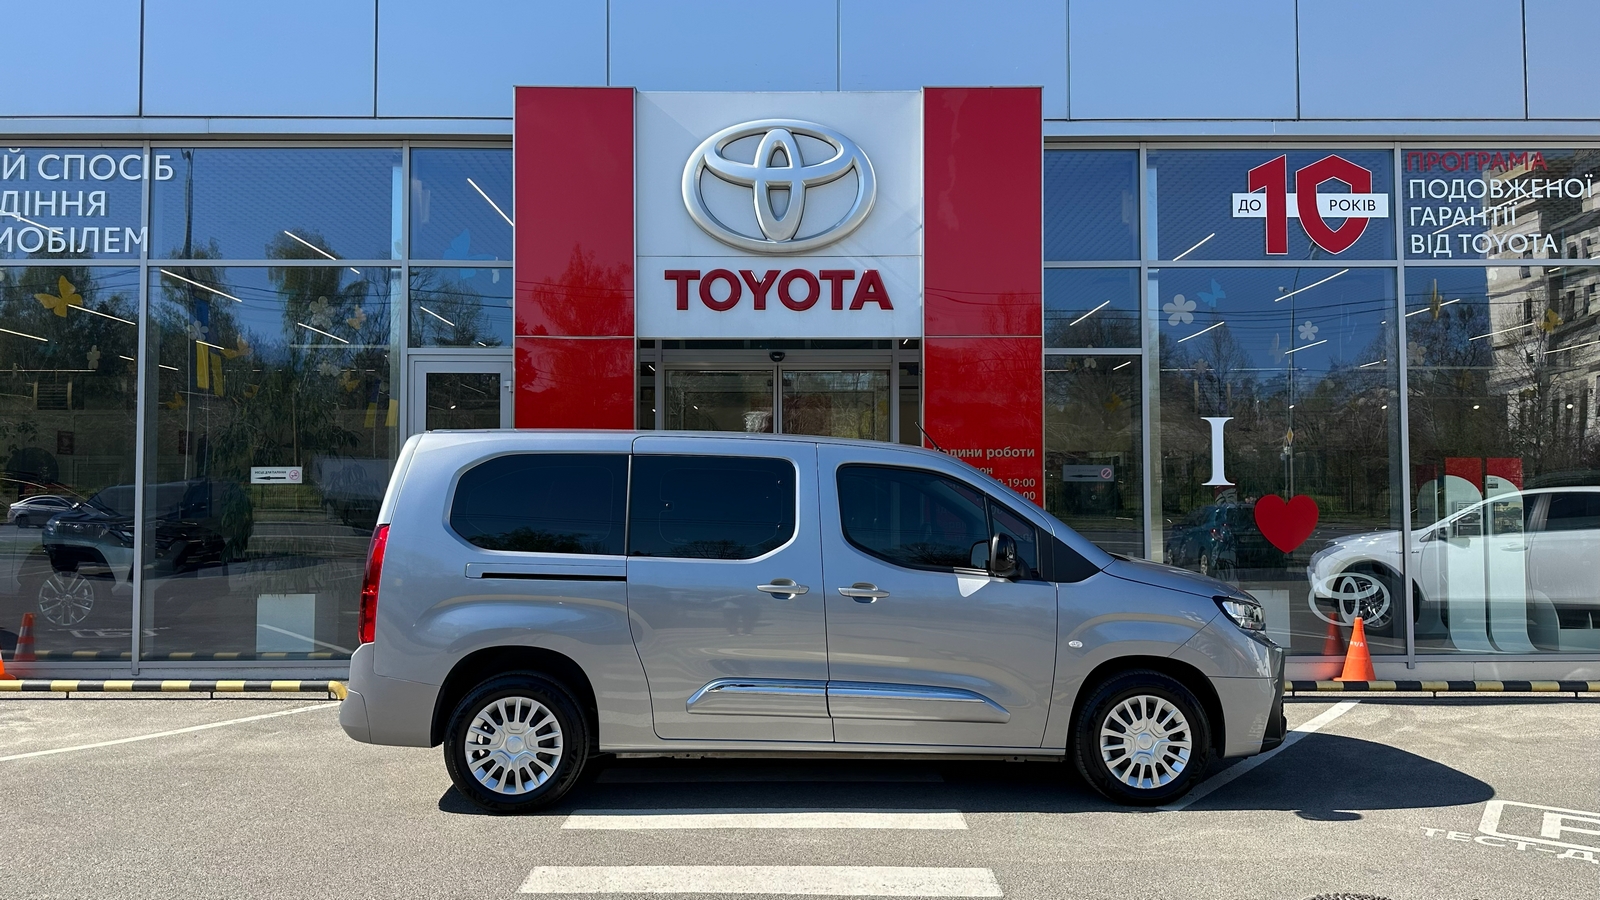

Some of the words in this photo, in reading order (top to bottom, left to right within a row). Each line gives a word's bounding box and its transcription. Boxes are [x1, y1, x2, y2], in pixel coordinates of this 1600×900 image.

[37, 154, 174, 180] СПОСІБ
[1407, 151, 1548, 171] ПРОГРАМА
[1409, 174, 1593, 202] ПОДОВЖЕНОЇ
[1238, 199, 1262, 213] ДО
[1329, 199, 1377, 211] РОКІВ
[1410, 204, 1516, 226] ГАРАНТІЇ
[1411, 234, 1452, 258] ВІД
[1458, 233, 1558, 254] TOYOTA
[664, 269, 894, 311] TOYOTA
[986, 446, 1035, 460] роботи
